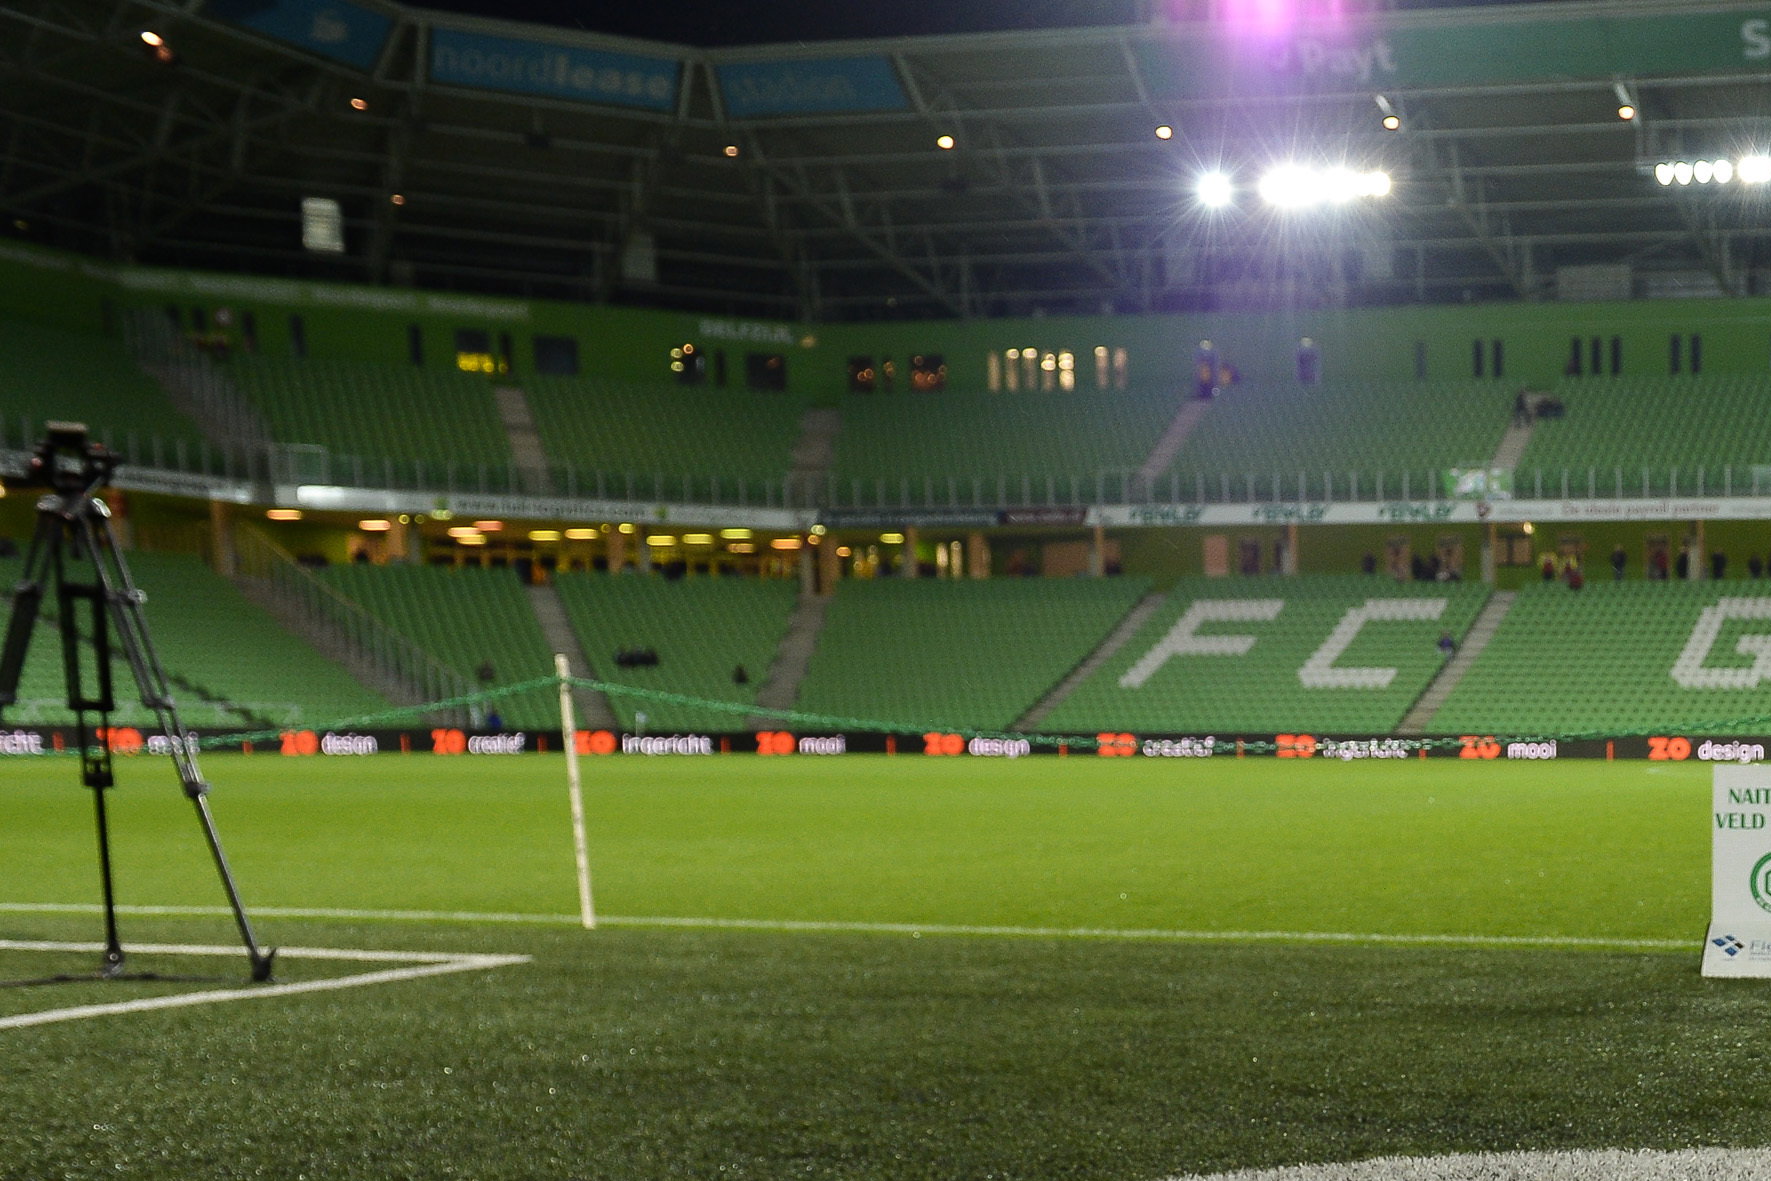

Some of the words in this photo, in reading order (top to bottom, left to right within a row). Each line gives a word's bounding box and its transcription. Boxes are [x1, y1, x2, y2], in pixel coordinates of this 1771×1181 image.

[433, 43, 672, 97] noordlease
[1119, 598, 1447, 689] FC
[1507, 739, 1557, 760] mooi
[1647, 737, 1692, 761] ZO
[1697, 740, 1765, 763] design
[1715, 812, 1766, 830] VELD
